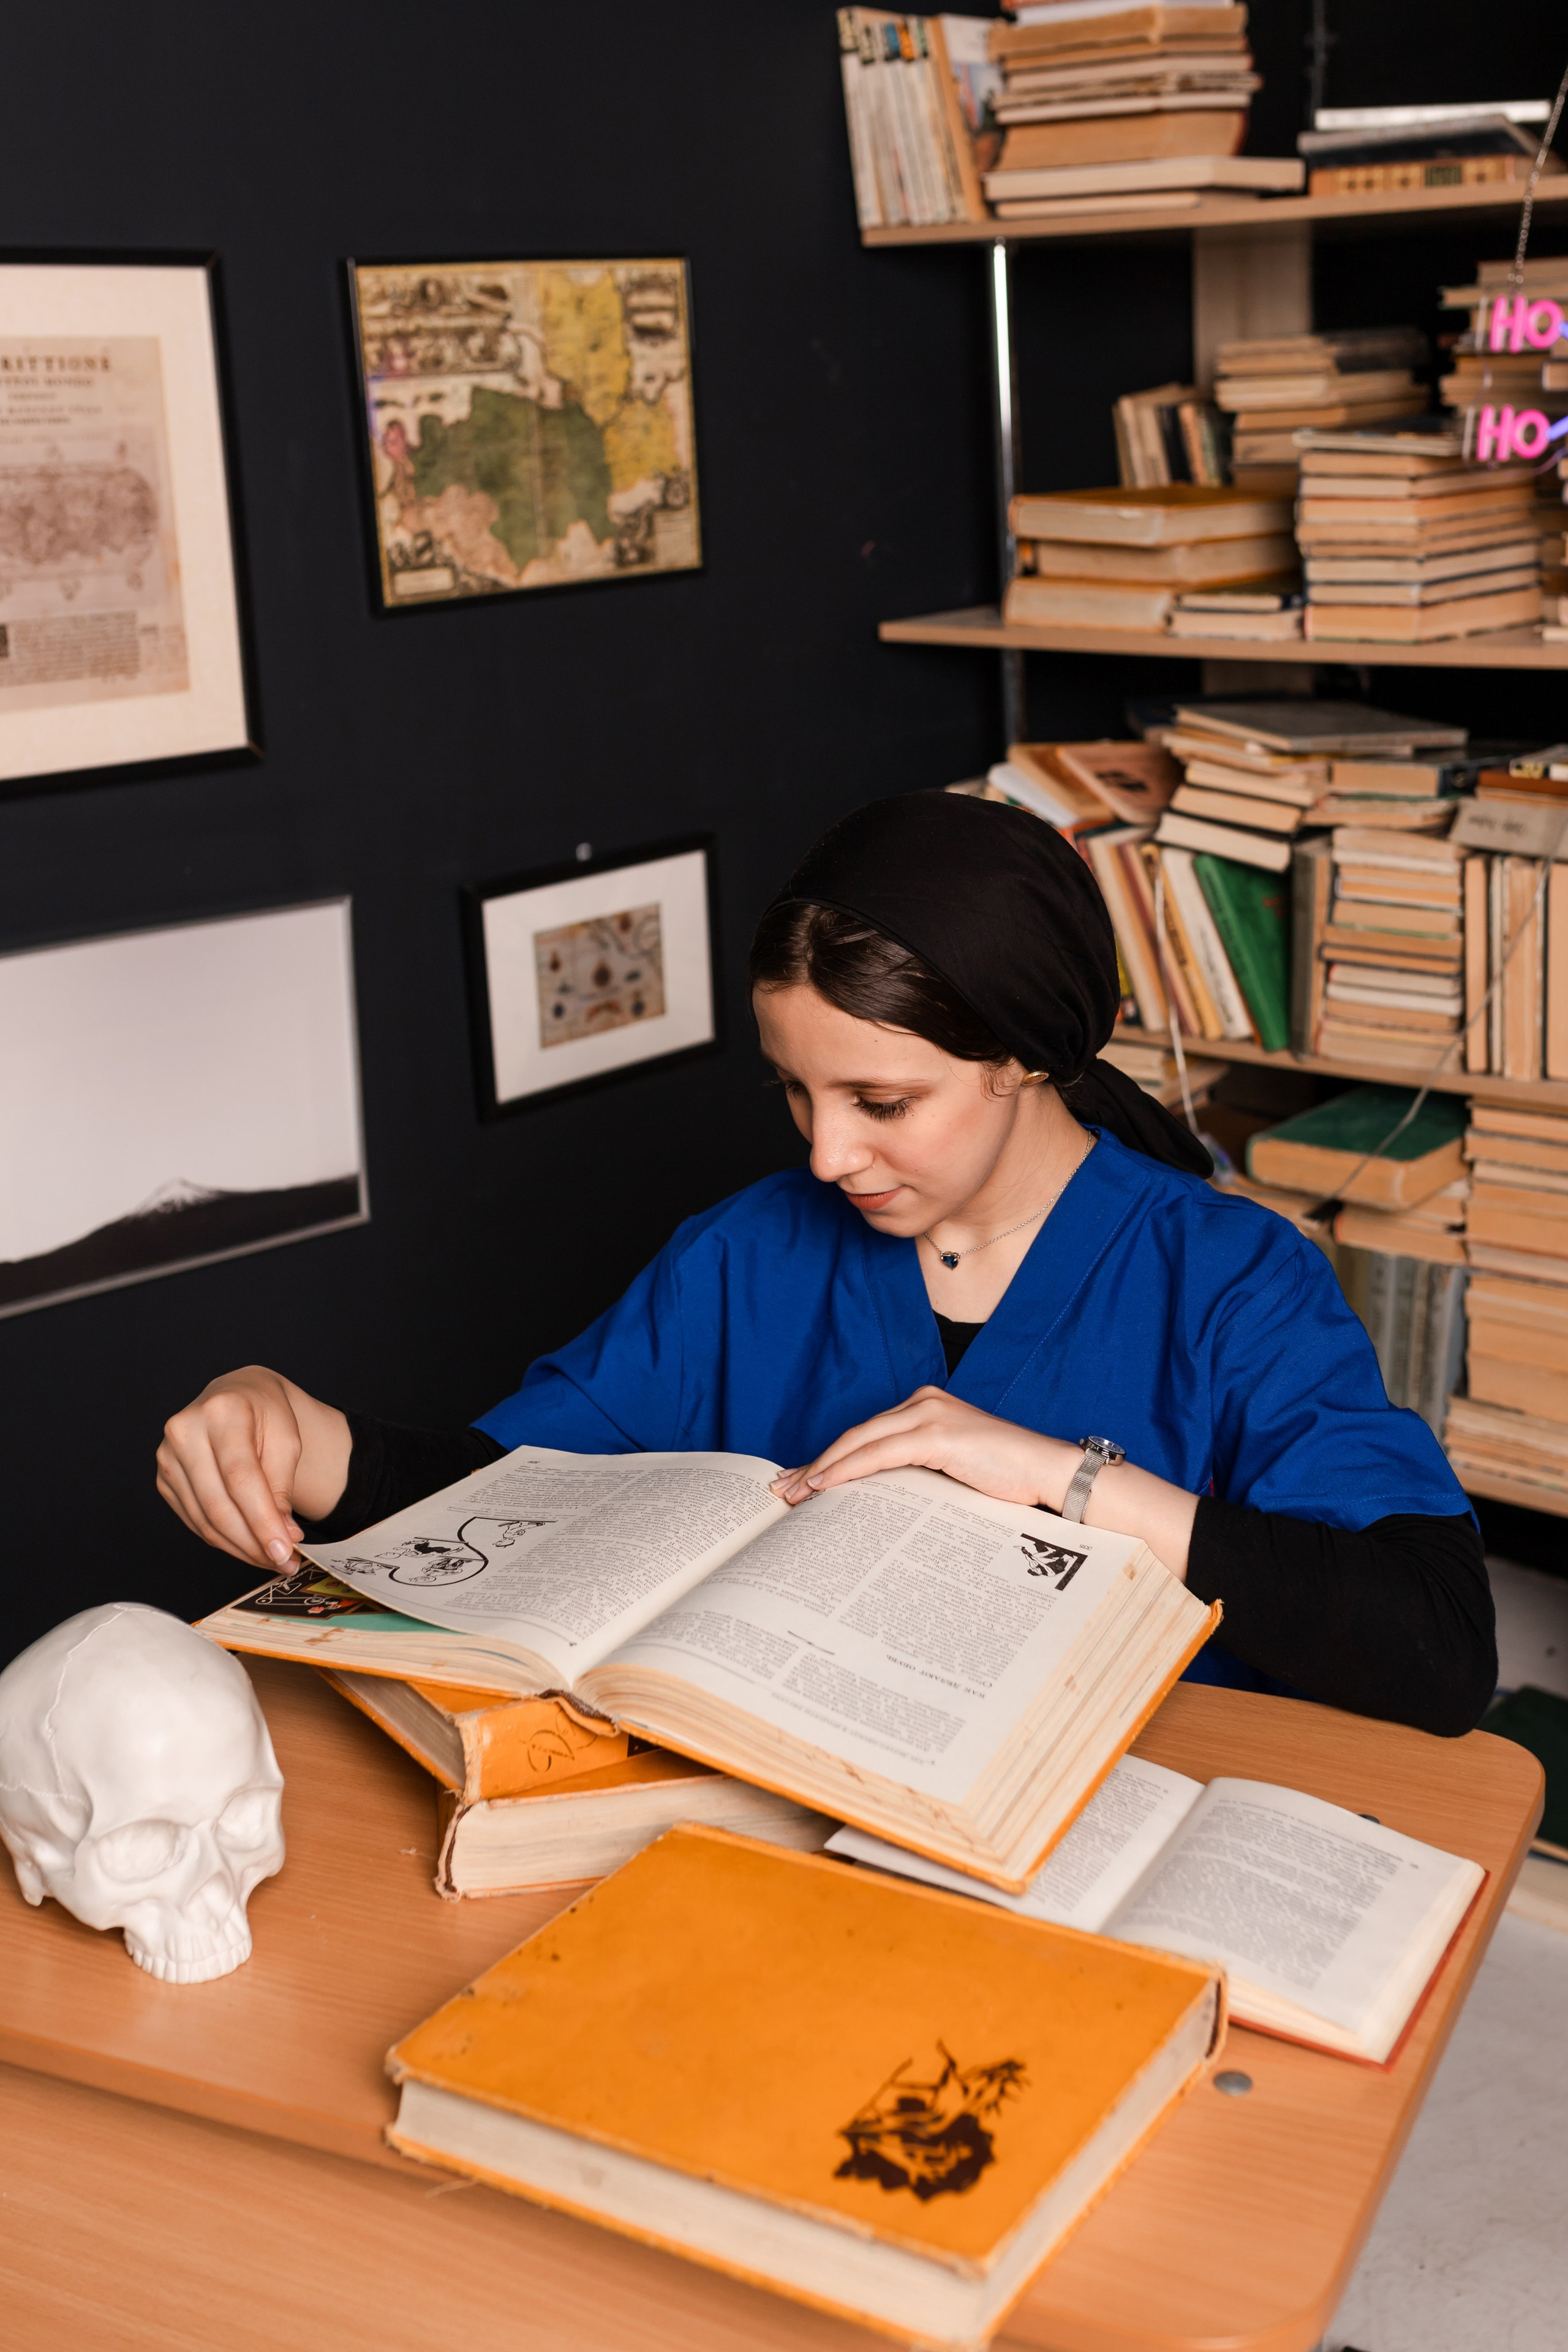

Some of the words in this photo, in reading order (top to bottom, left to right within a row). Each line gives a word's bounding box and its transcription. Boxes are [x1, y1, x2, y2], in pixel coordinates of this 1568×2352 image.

[1489, 294, 1564, 353] HO
[1476, 404, 1551, 462] HO
[962, 1687, 986, 1699] КАК
